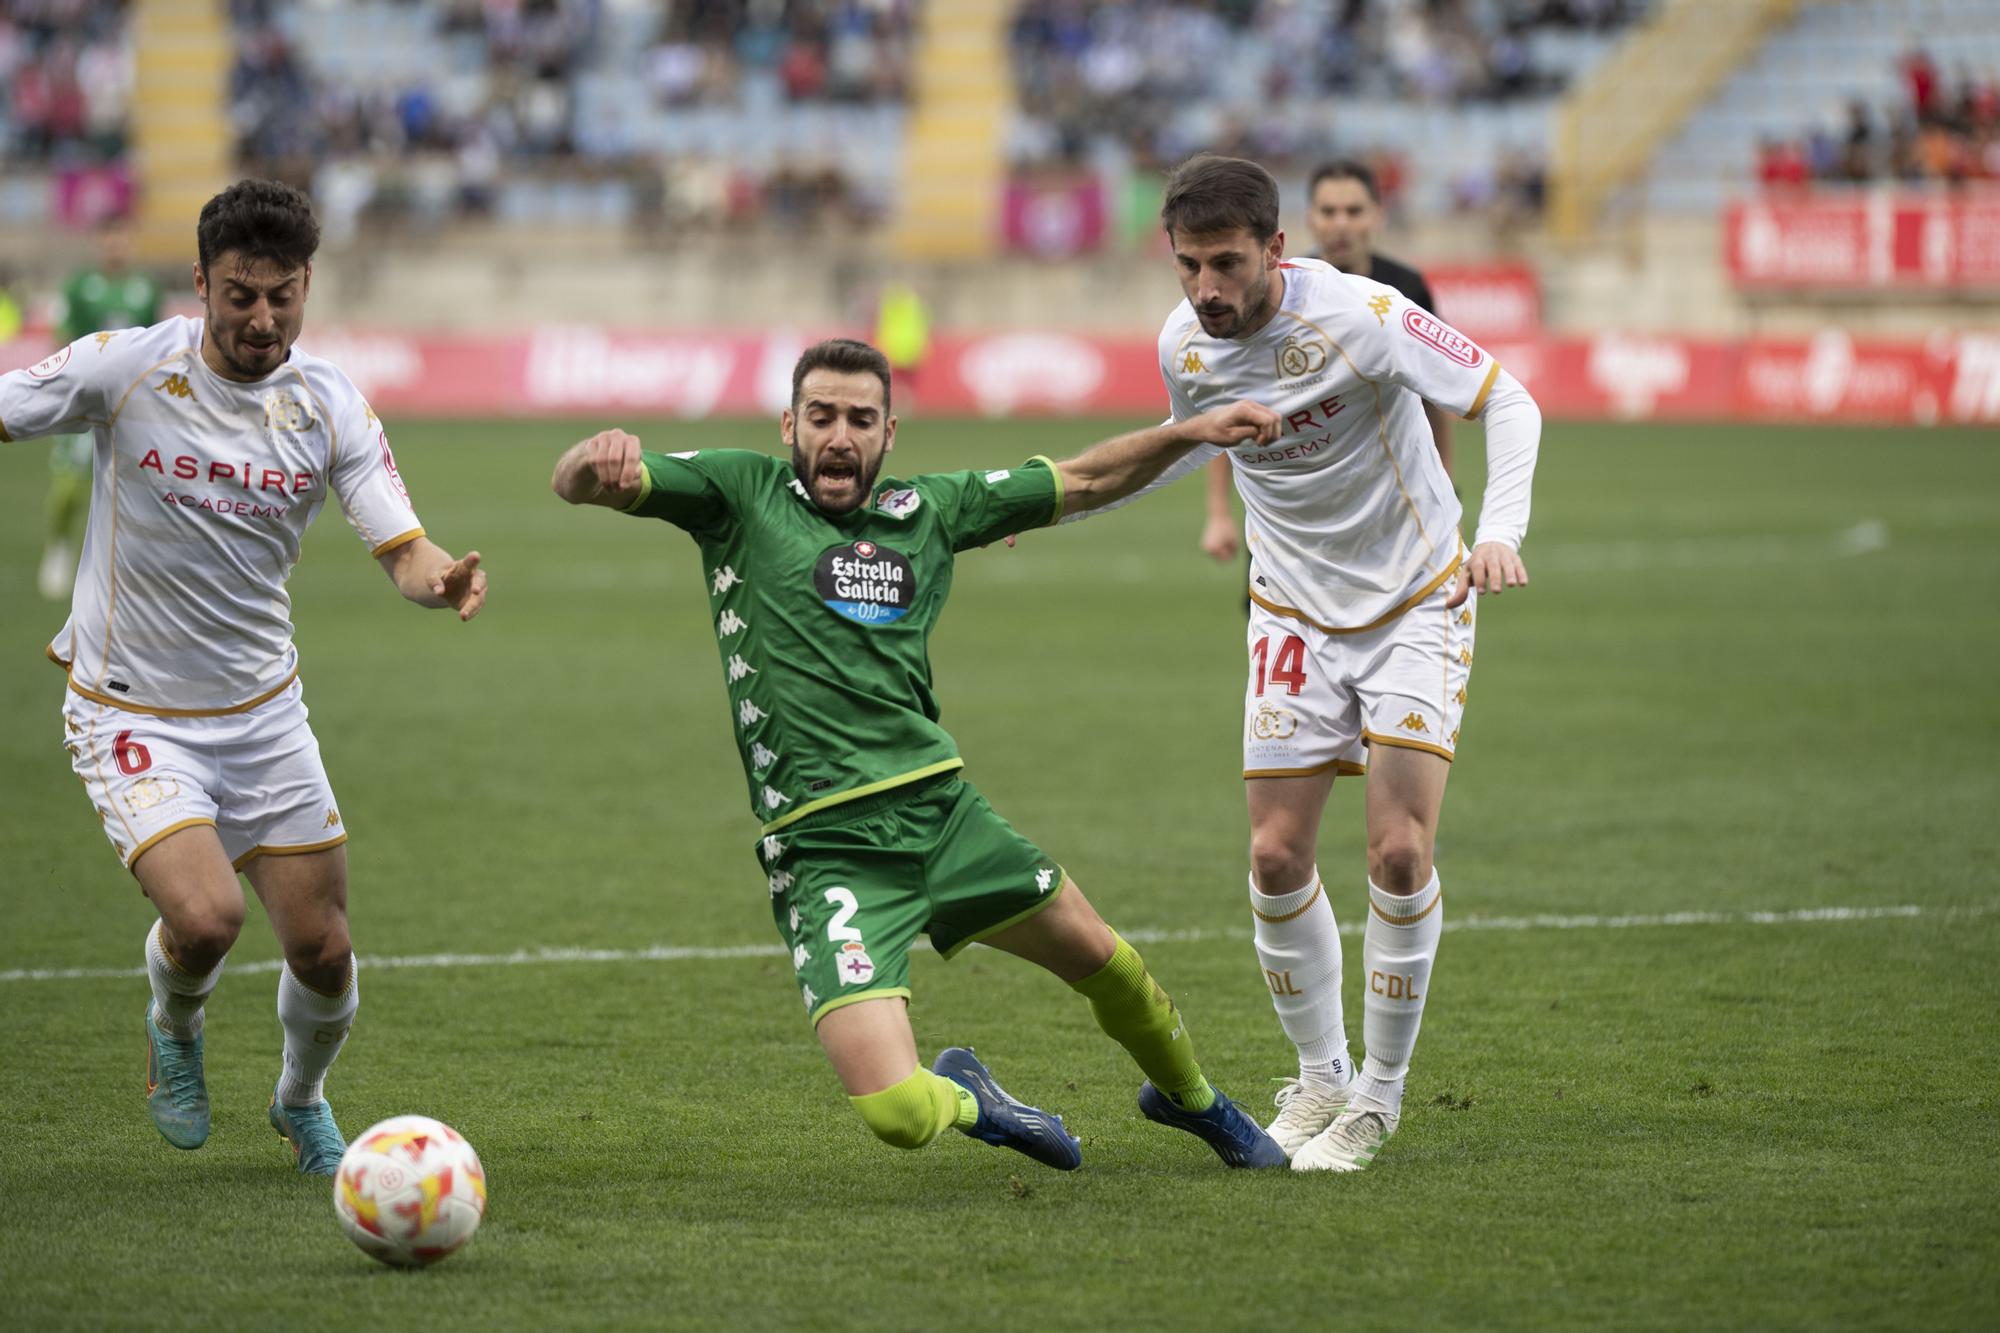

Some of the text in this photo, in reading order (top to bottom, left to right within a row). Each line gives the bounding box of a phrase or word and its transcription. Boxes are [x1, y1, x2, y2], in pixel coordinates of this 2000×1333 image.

[1241, 432, 1332, 464] CADEMY
[162, 491, 287, 519] ACADEMY
[831, 556, 904, 582] Estrella
[834, 576, 900, 604] Galicia
[1252, 634, 1308, 697] 14
[111, 729, 153, 777] 6
[823, 886, 863, 943] 2
[1265, 968, 1304, 997] DL
[1370, 969, 1419, 1000] CDL
